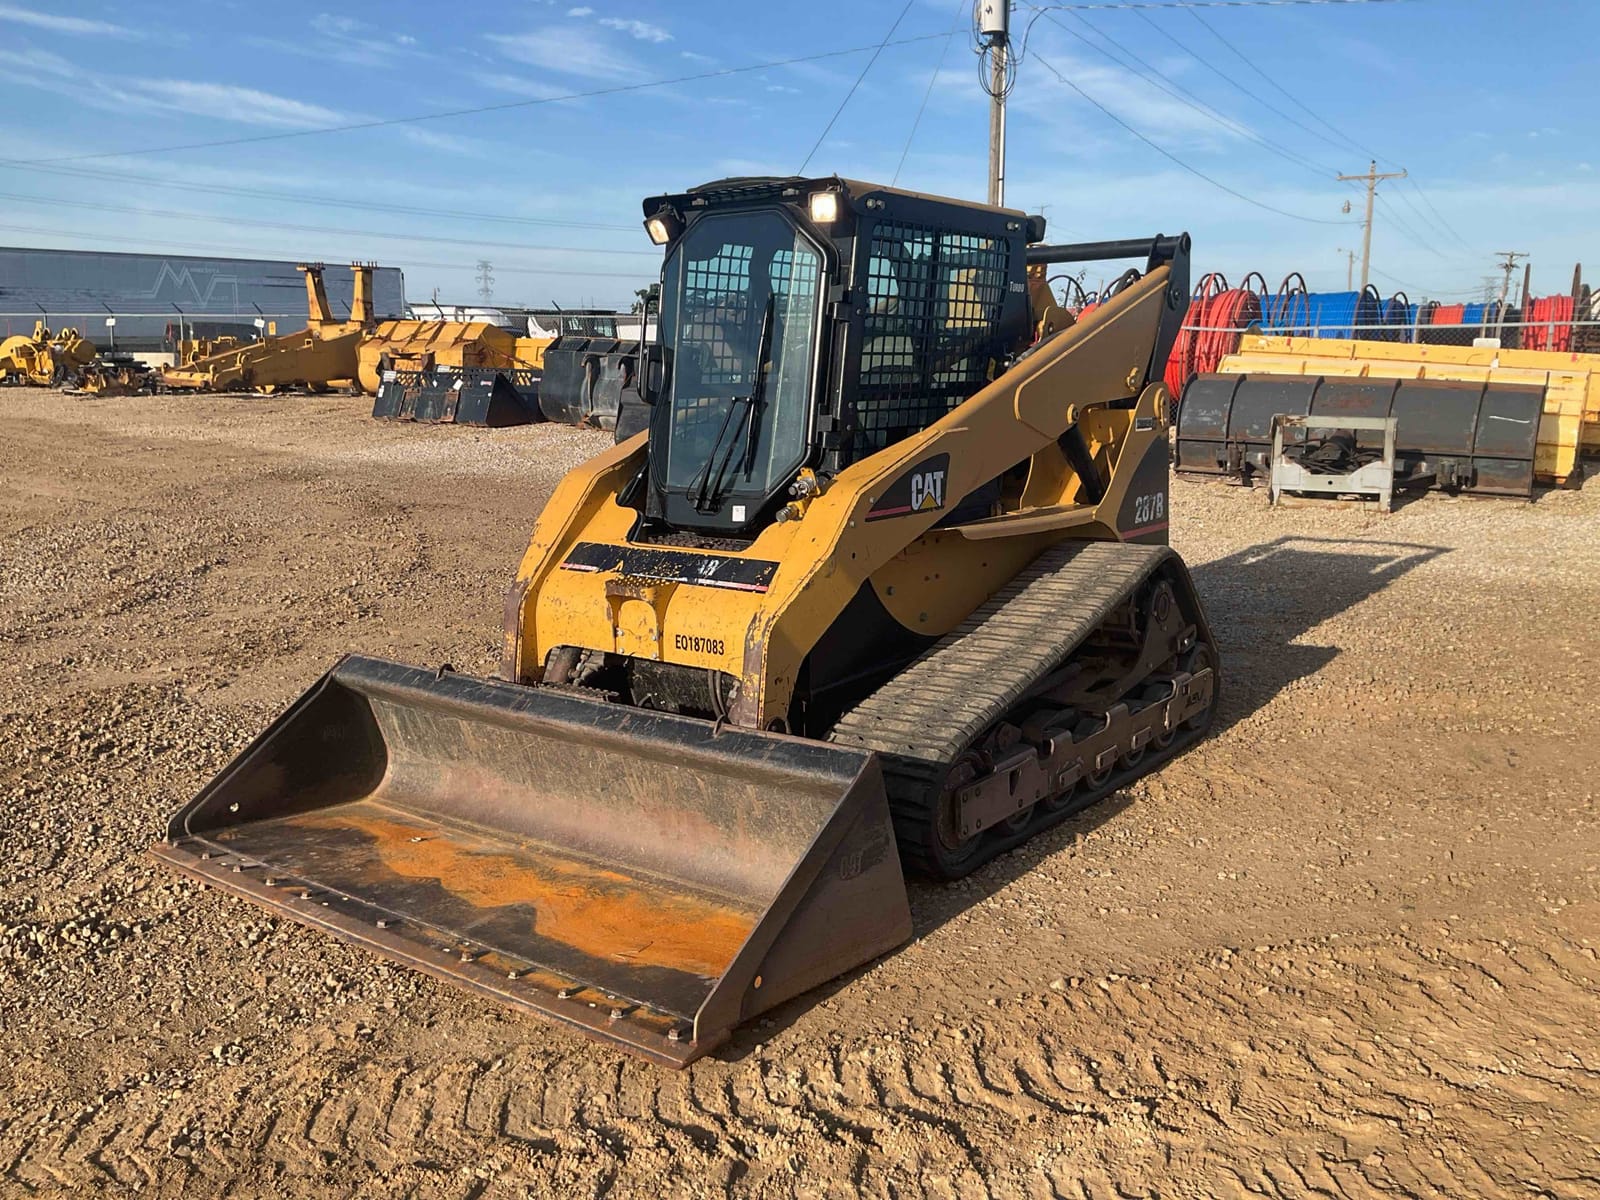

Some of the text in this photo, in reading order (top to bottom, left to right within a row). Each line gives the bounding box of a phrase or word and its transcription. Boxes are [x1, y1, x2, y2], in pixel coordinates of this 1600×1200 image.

[911, 471, 944, 511] CAT
[1134, 492, 1164, 524] 287B
[675, 634, 725, 656] EQ187083
